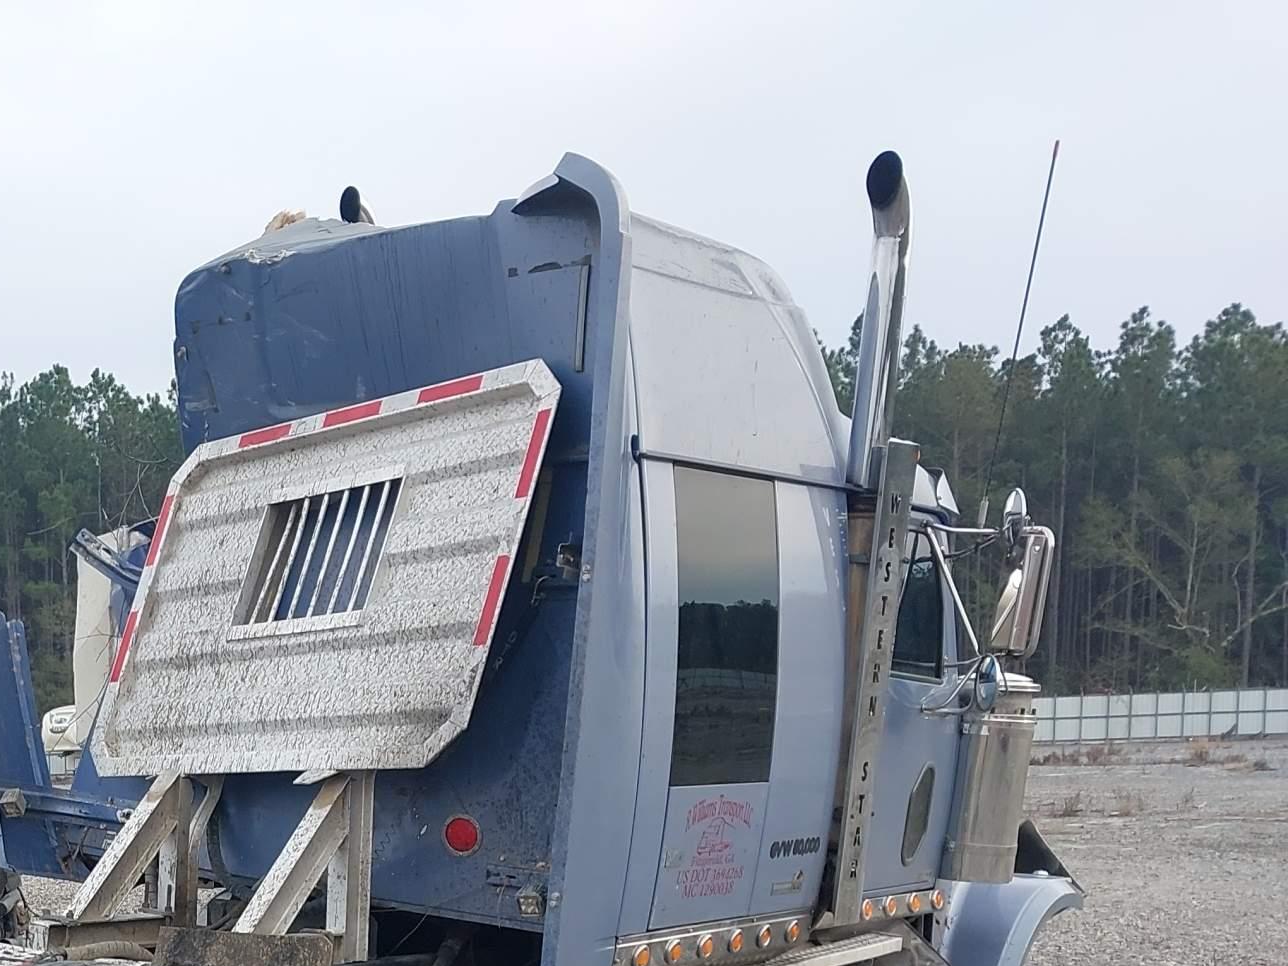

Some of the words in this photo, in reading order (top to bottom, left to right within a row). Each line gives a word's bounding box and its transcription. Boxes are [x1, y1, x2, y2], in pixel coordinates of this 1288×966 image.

[868, 493, 902, 717] WESTERN
[690, 867, 712, 883] DOT
[849, 760, 869, 879] STAR
